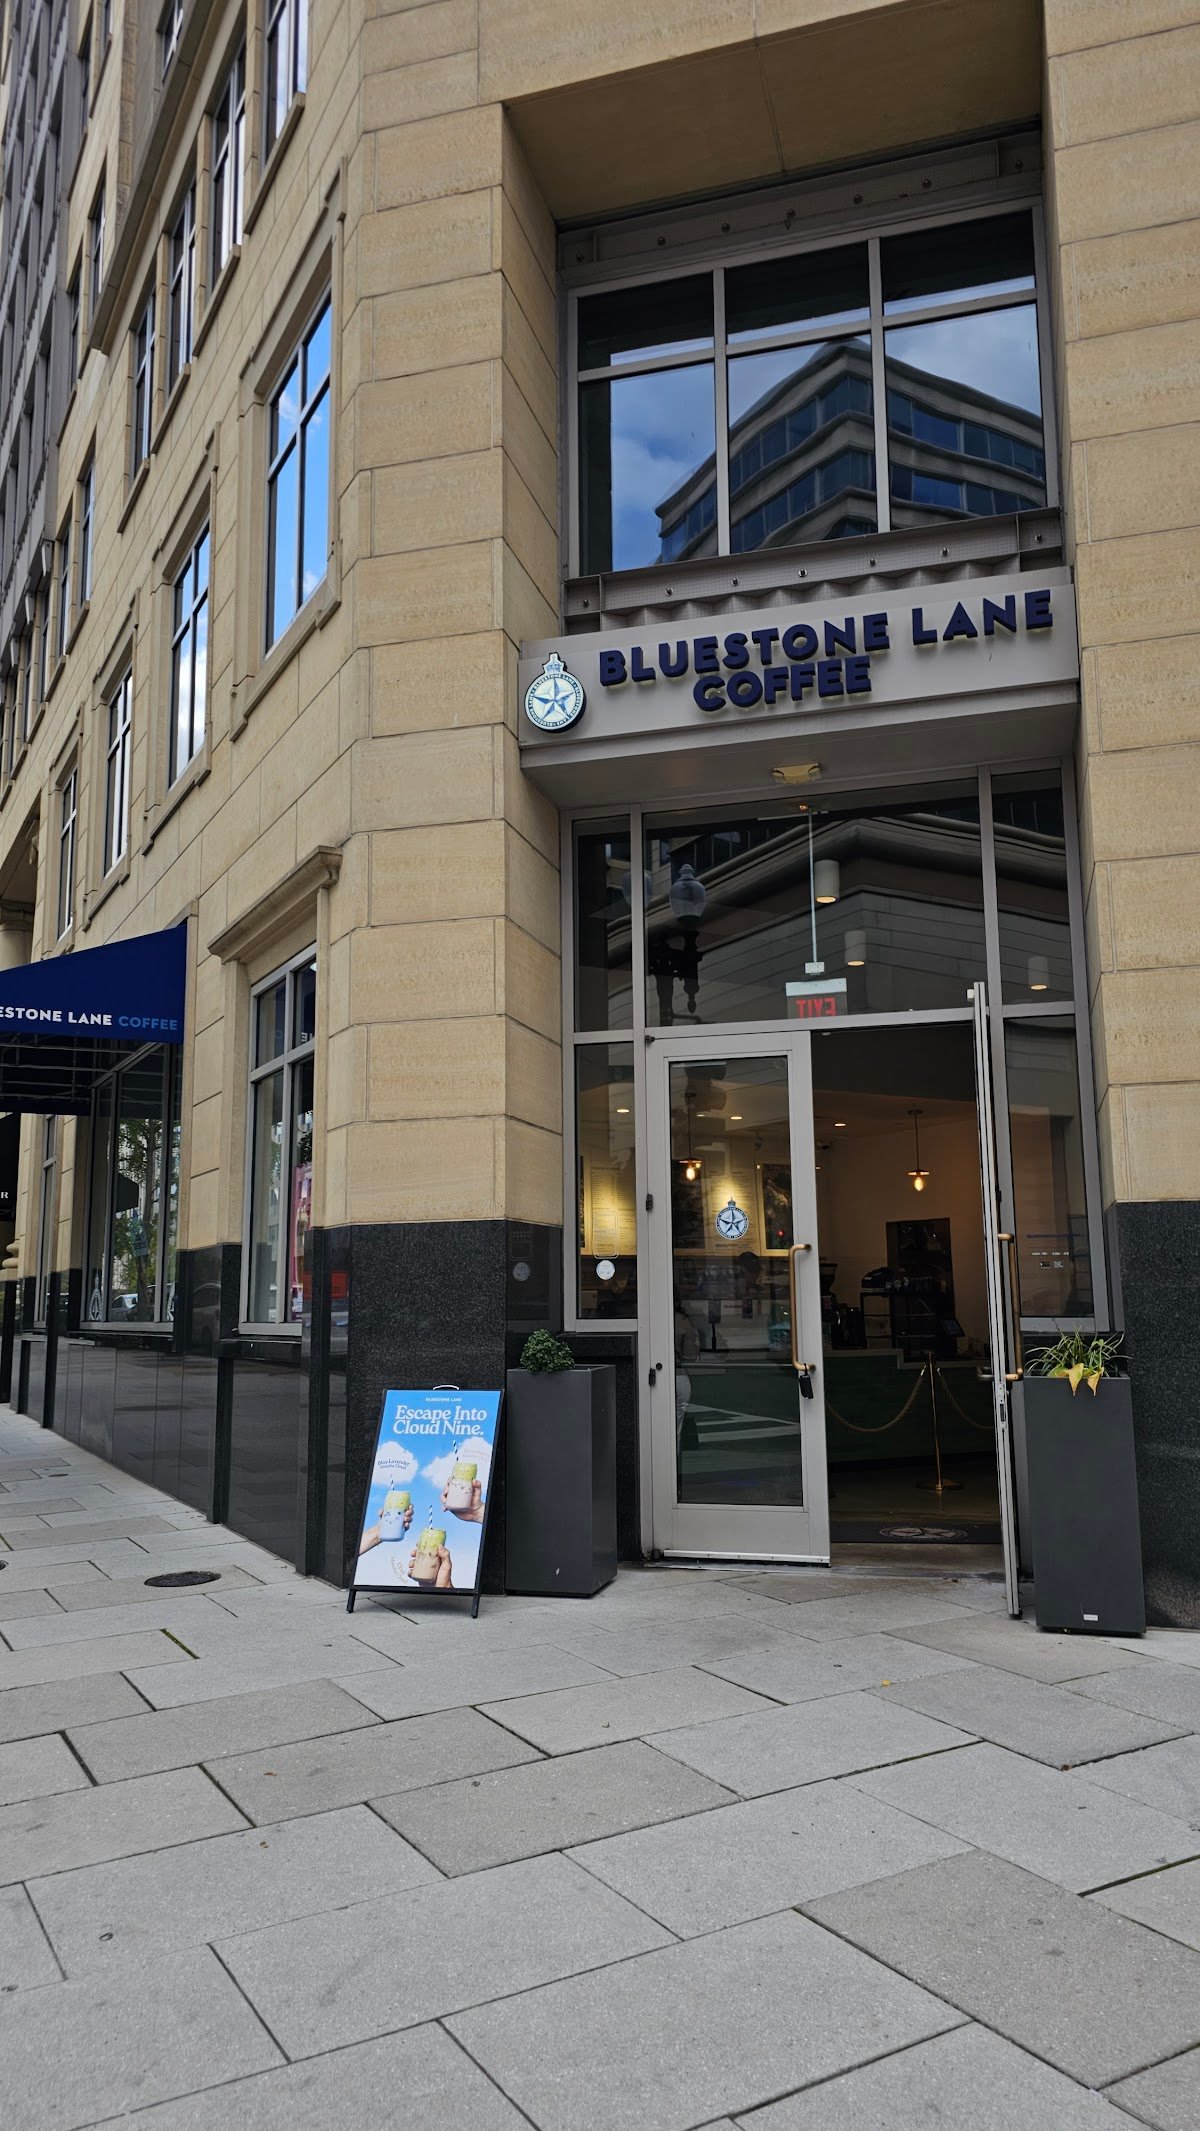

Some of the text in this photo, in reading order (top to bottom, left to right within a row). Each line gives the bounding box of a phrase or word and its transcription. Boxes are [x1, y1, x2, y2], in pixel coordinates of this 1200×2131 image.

[600, 589, 1053, 687] BLUESTONE LANE
[693, 655, 872, 712] COFFEE
[68, 1011, 112, 1026] LANE
[118, 1015, 178, 1031] COFFEE
[395, 1405, 487, 1424] Escape Into
[393, 1420, 484, 1435] Cloud Nine.
